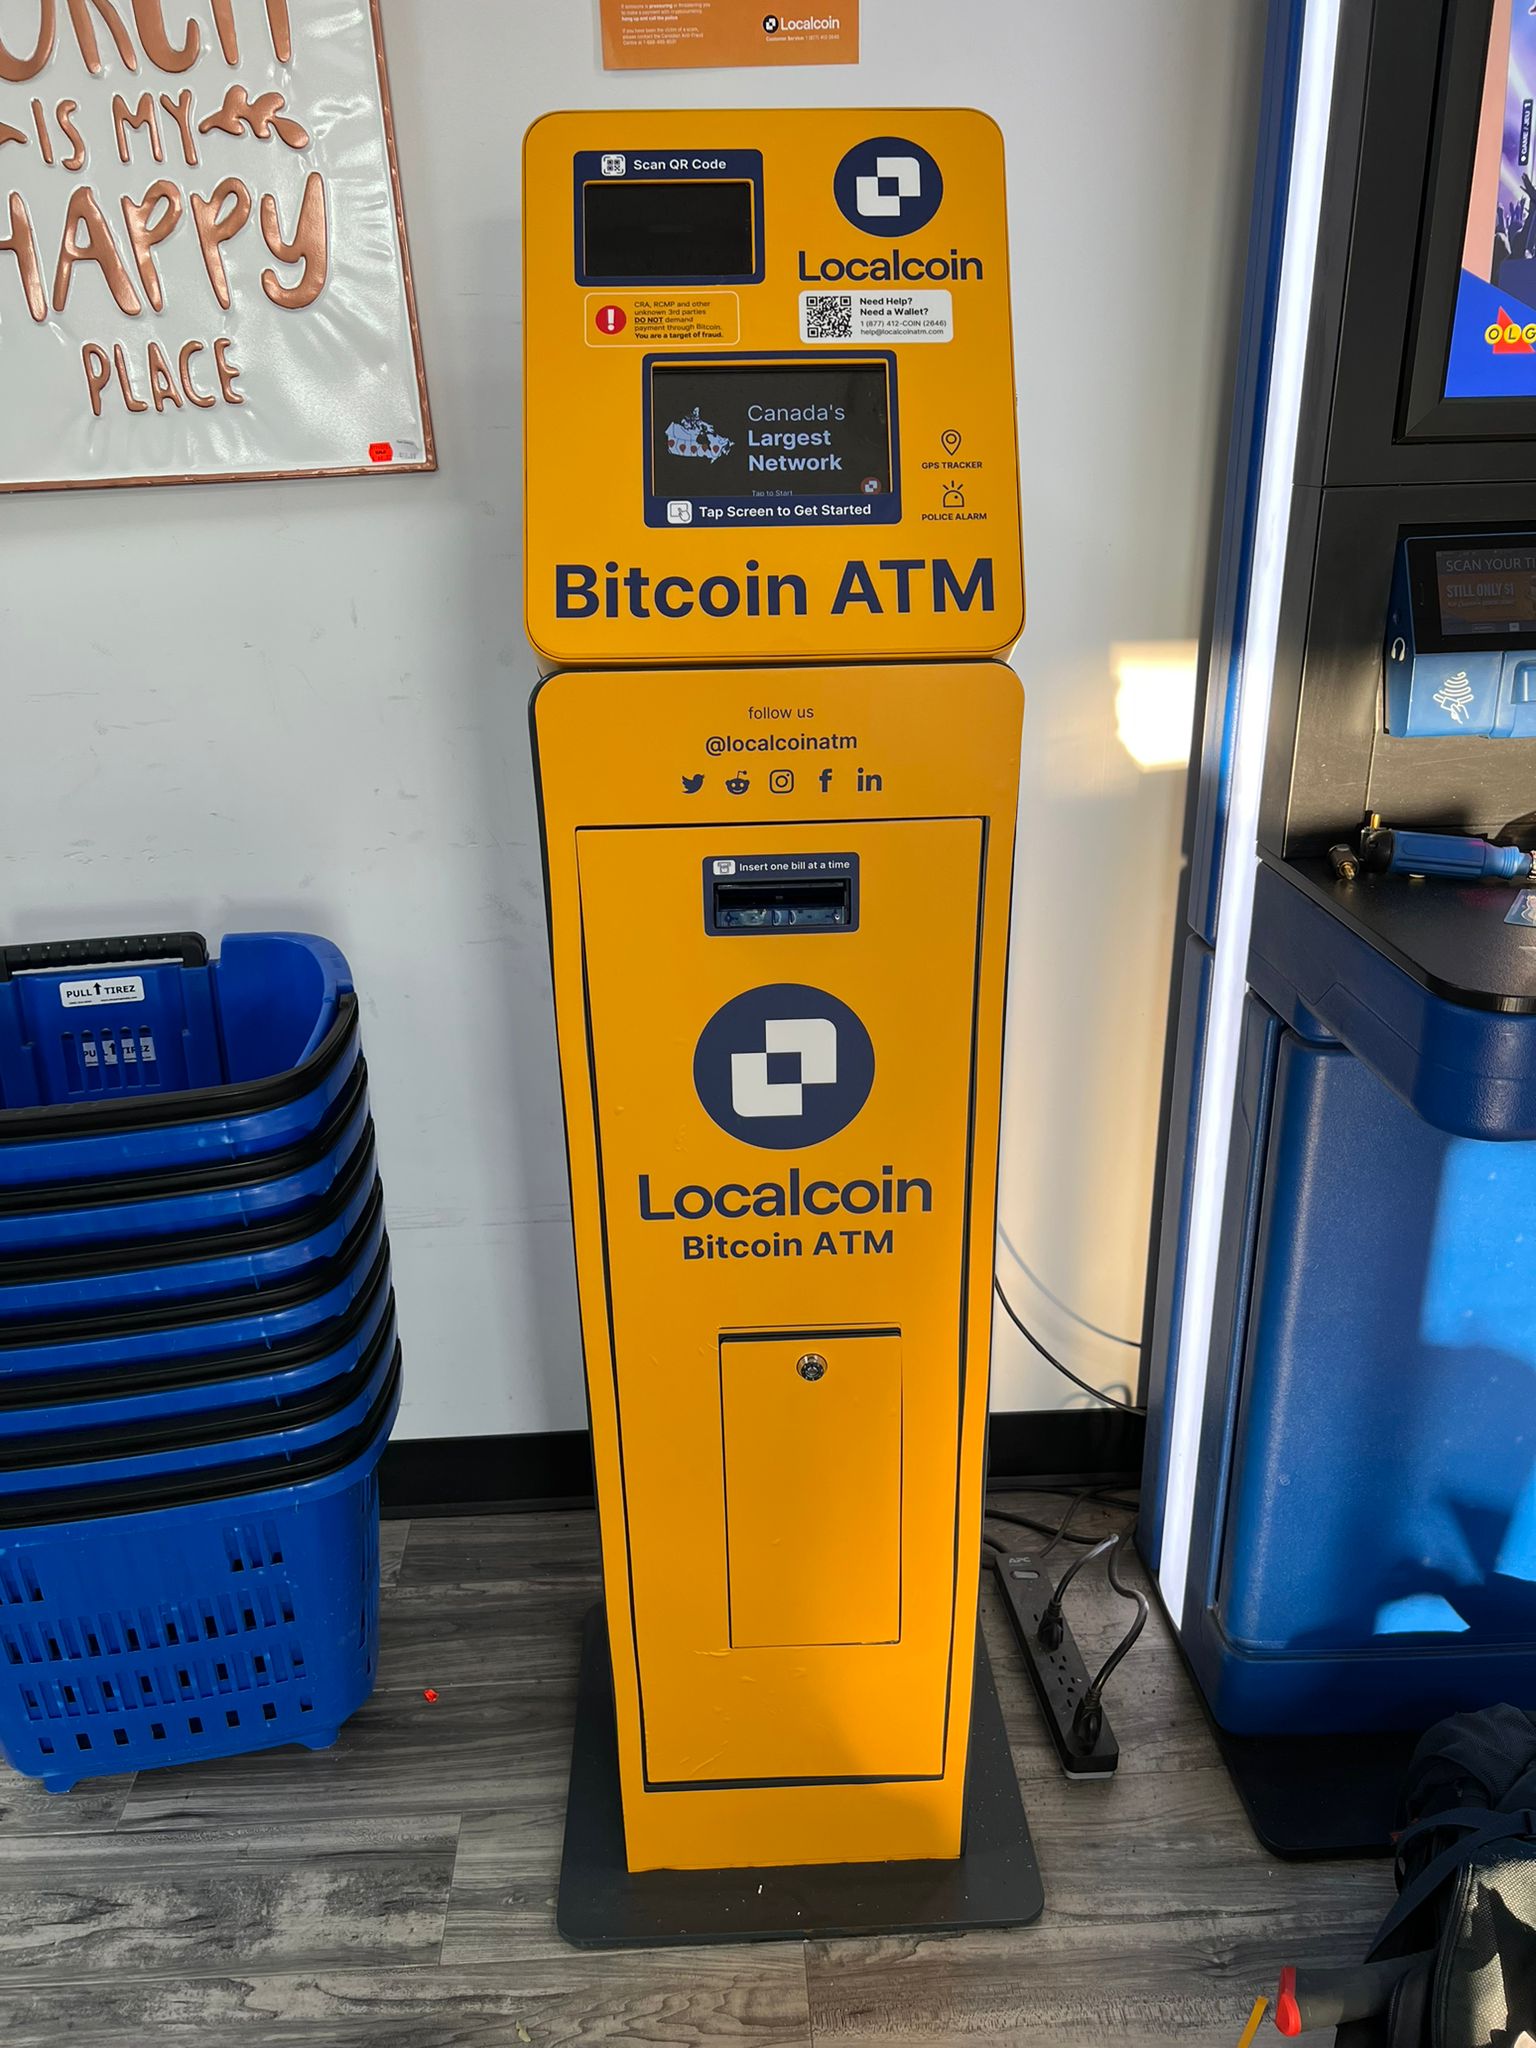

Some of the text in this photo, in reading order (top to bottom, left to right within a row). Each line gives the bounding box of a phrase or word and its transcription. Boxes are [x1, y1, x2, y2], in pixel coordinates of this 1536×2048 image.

[780, 16, 840, 31] Localcoin
[30, 89, 199, 171] IS MY
[633, 158, 727, 170] Scan QR Code
[798, 249, 984, 282] Localcoin
[860, 297, 912, 307] Need Help?
[860, 308, 885, 316] Need
[894, 308, 929, 316] Wallet?
[667, 324, 695, 332] through
[866, 320, 885, 328] (877)
[670, 332, 691, 340] target
[860, 328, 944, 337] help@localcoinatm.com
[81, 338, 246, 416] PLACE
[748, 404, 845, 422] Canada's
[748, 429, 832, 450] Largest
[748, 454, 842, 472] Network
[942, 461, 983, 469] TRACKER
[699, 504, 872, 520] Tap Screen to Get Started
[1446, 559, 1480, 572] SCAN
[1485, 558, 1522, 570] YOUR
[555, 557, 995, 618] Bitcoin ATM
[748, 706, 814, 719] follow us
[705, 733, 858, 757] @localcoinatm
[739, 863, 768, 872] Insert
[770, 863, 789, 871] one
[791, 862, 806, 870] bill
[828, 860, 850, 869] time
[66, 985, 135, 998] PULL TIREZ
[638, 1165, 932, 1221] Localcoin
[683, 1230, 893, 1260] Bitcoin ATM
